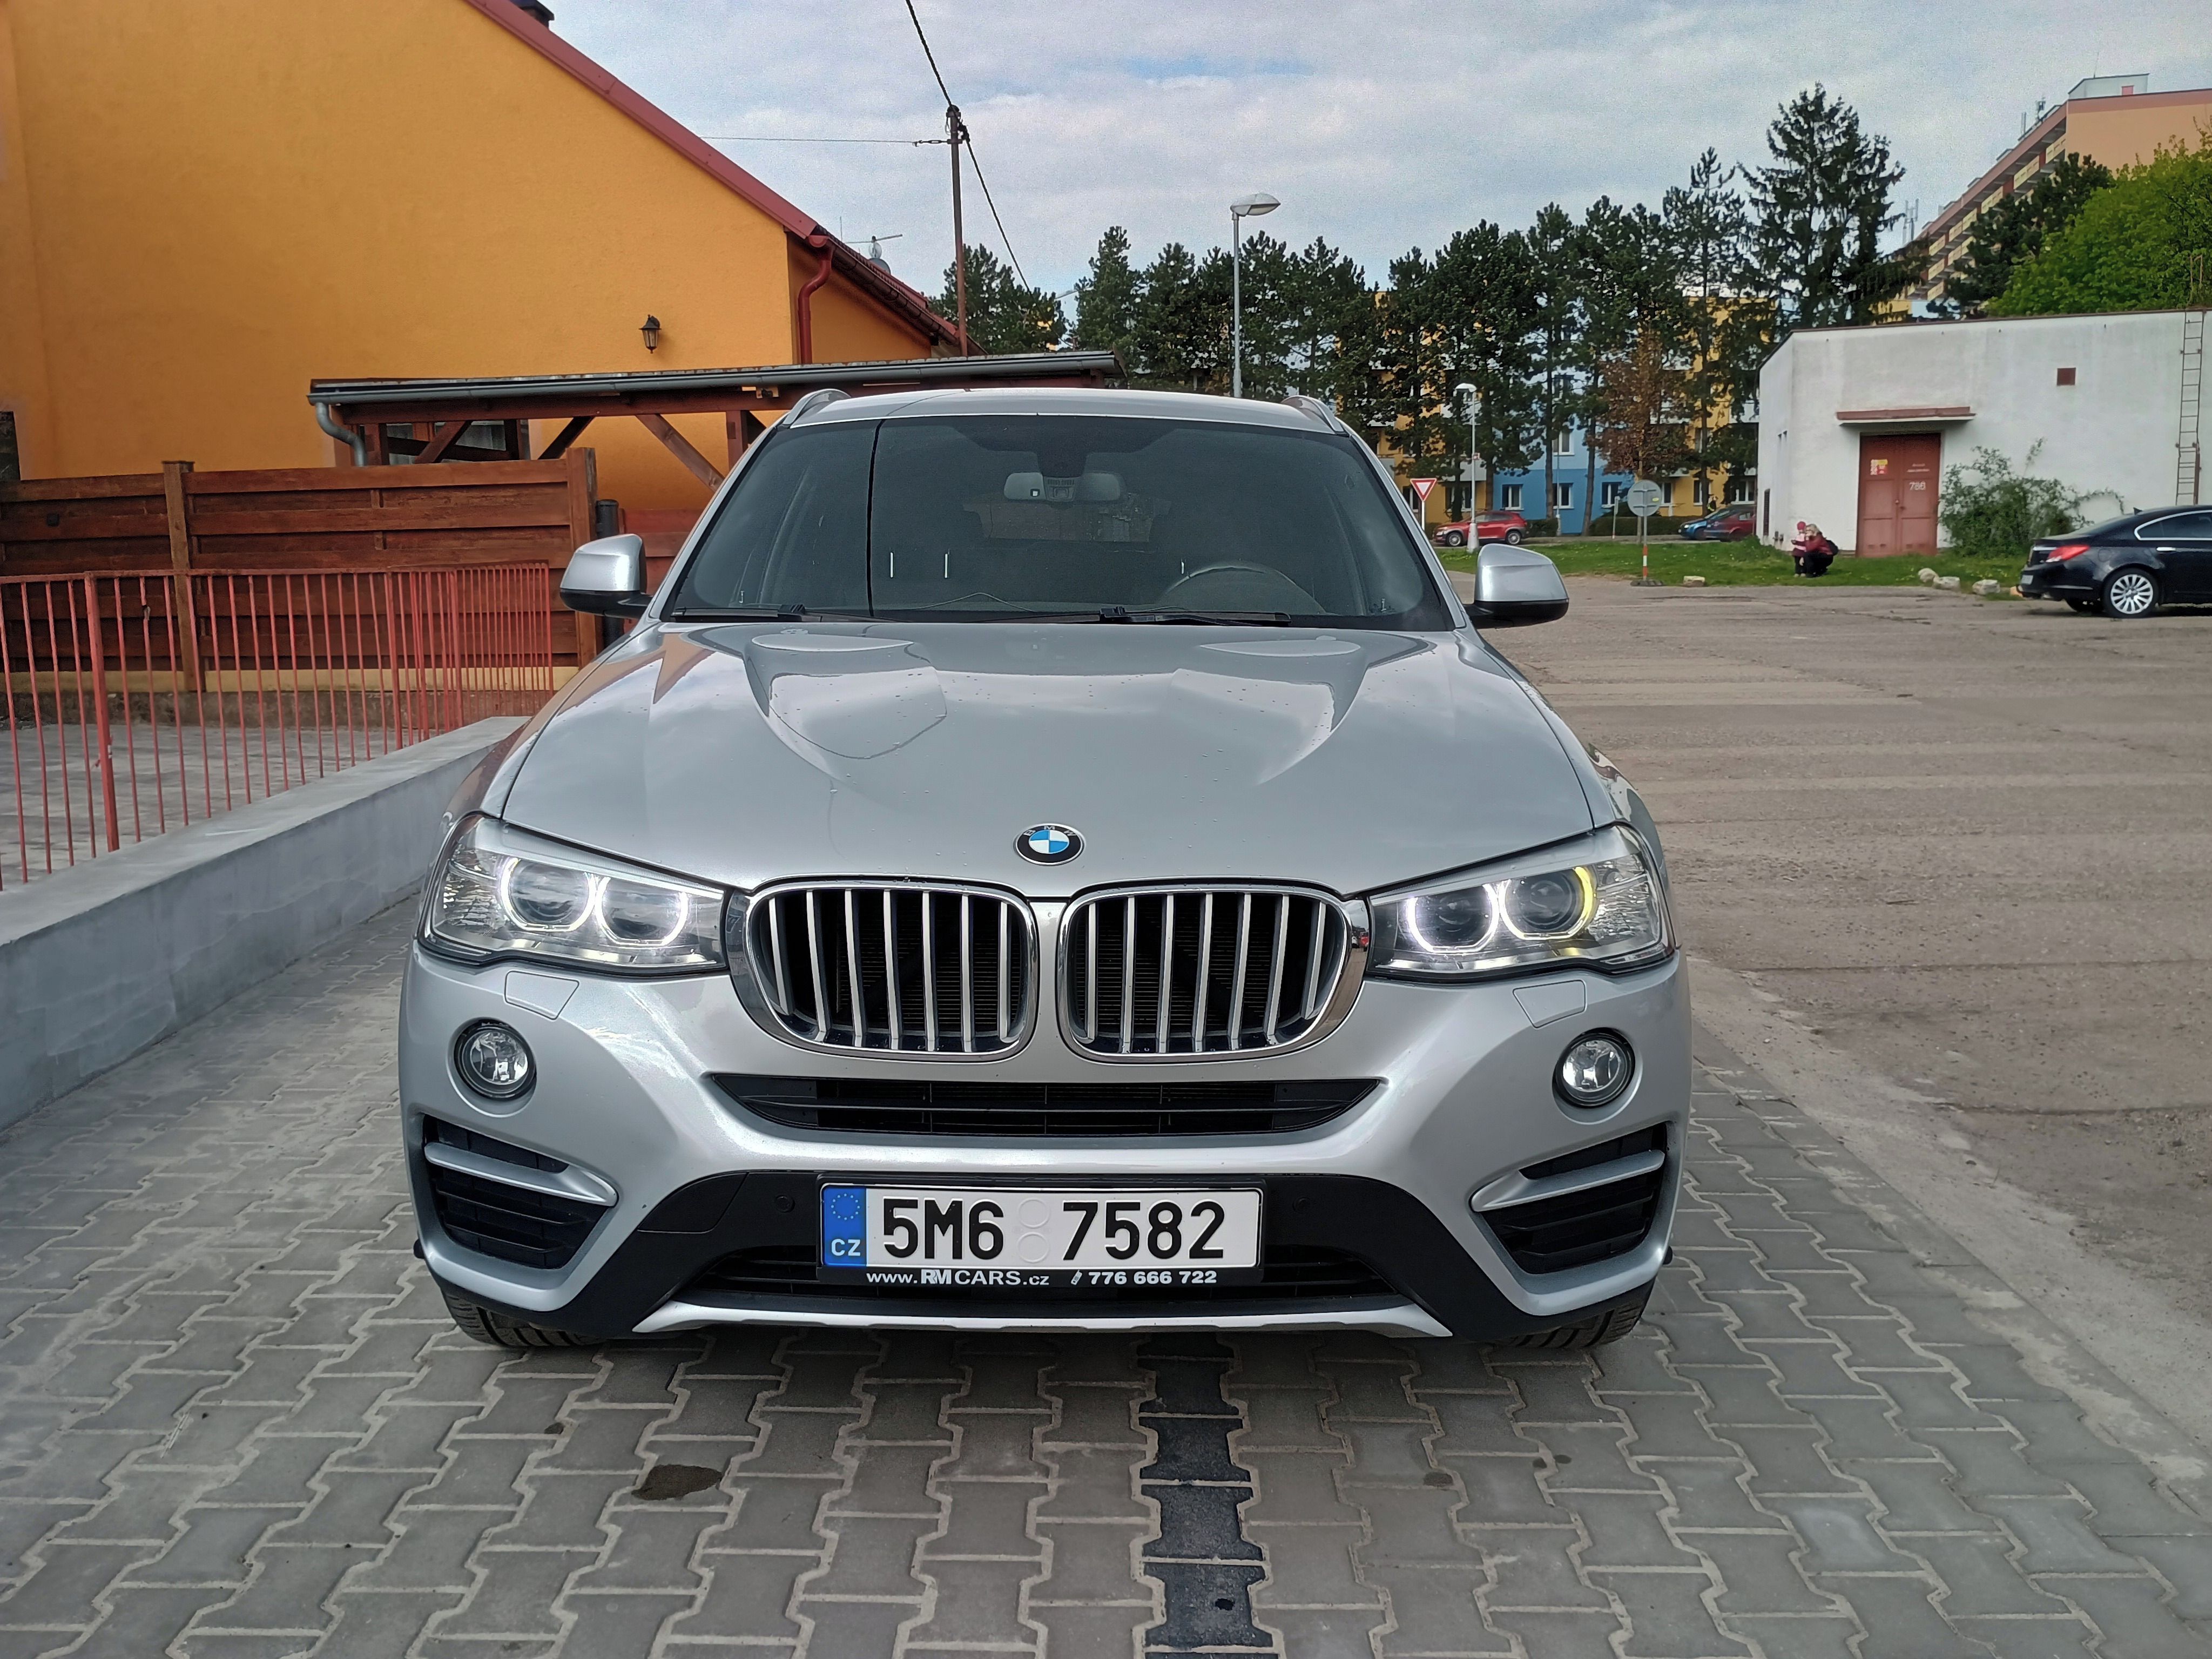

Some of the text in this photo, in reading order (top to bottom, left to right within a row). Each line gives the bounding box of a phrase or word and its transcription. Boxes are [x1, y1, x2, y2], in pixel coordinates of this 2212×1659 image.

[1023, 825, 1076, 837] BMW
[884, 1198, 1224, 1260] 5M6 7582
[831, 1238, 861, 1257] CZ
[867, 1269, 1217, 1285] www.RMCARS.cz 776 666 722
